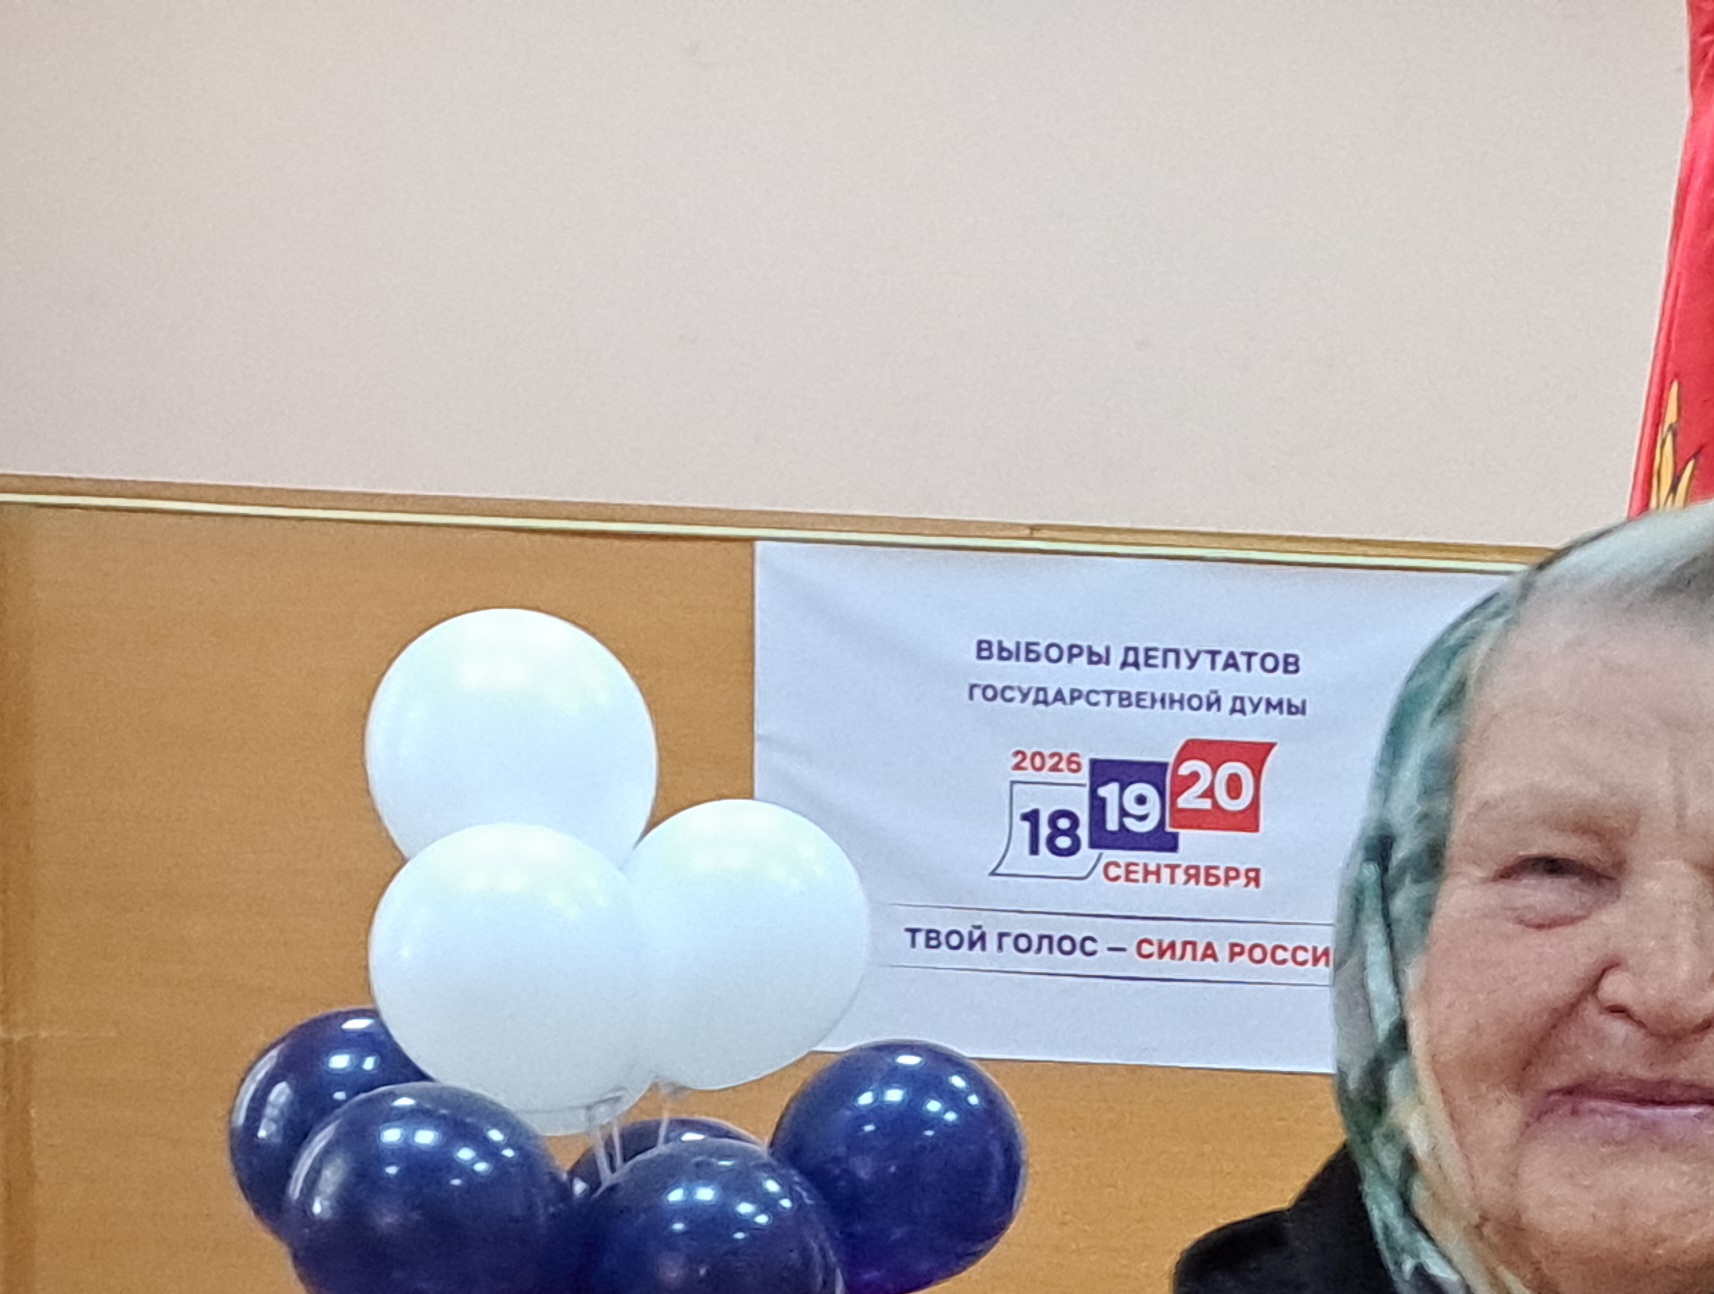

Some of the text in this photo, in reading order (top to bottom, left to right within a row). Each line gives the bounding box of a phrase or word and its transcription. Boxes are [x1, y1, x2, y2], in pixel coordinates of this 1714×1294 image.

[976, 639, 1301, 674] ВЫБОРЫ ДЕПУТАТОВ
[968, 683, 1307, 717] ГОСУДАРСТВЕННОЙ ДУМЫ
[1011, 750, 1083, 774] 2026
[1019, 760, 1254, 857] 18 19 20
[1103, 861, 1261, 888] СЕНТЯБРЯ
[905, 925, 986, 953] ТВОЙ
[997, 932, 1098, 957] ГОЛОС
[1135, 938, 1219, 962] СИЛА
[1228, 942, 1331, 967] РОССИ
